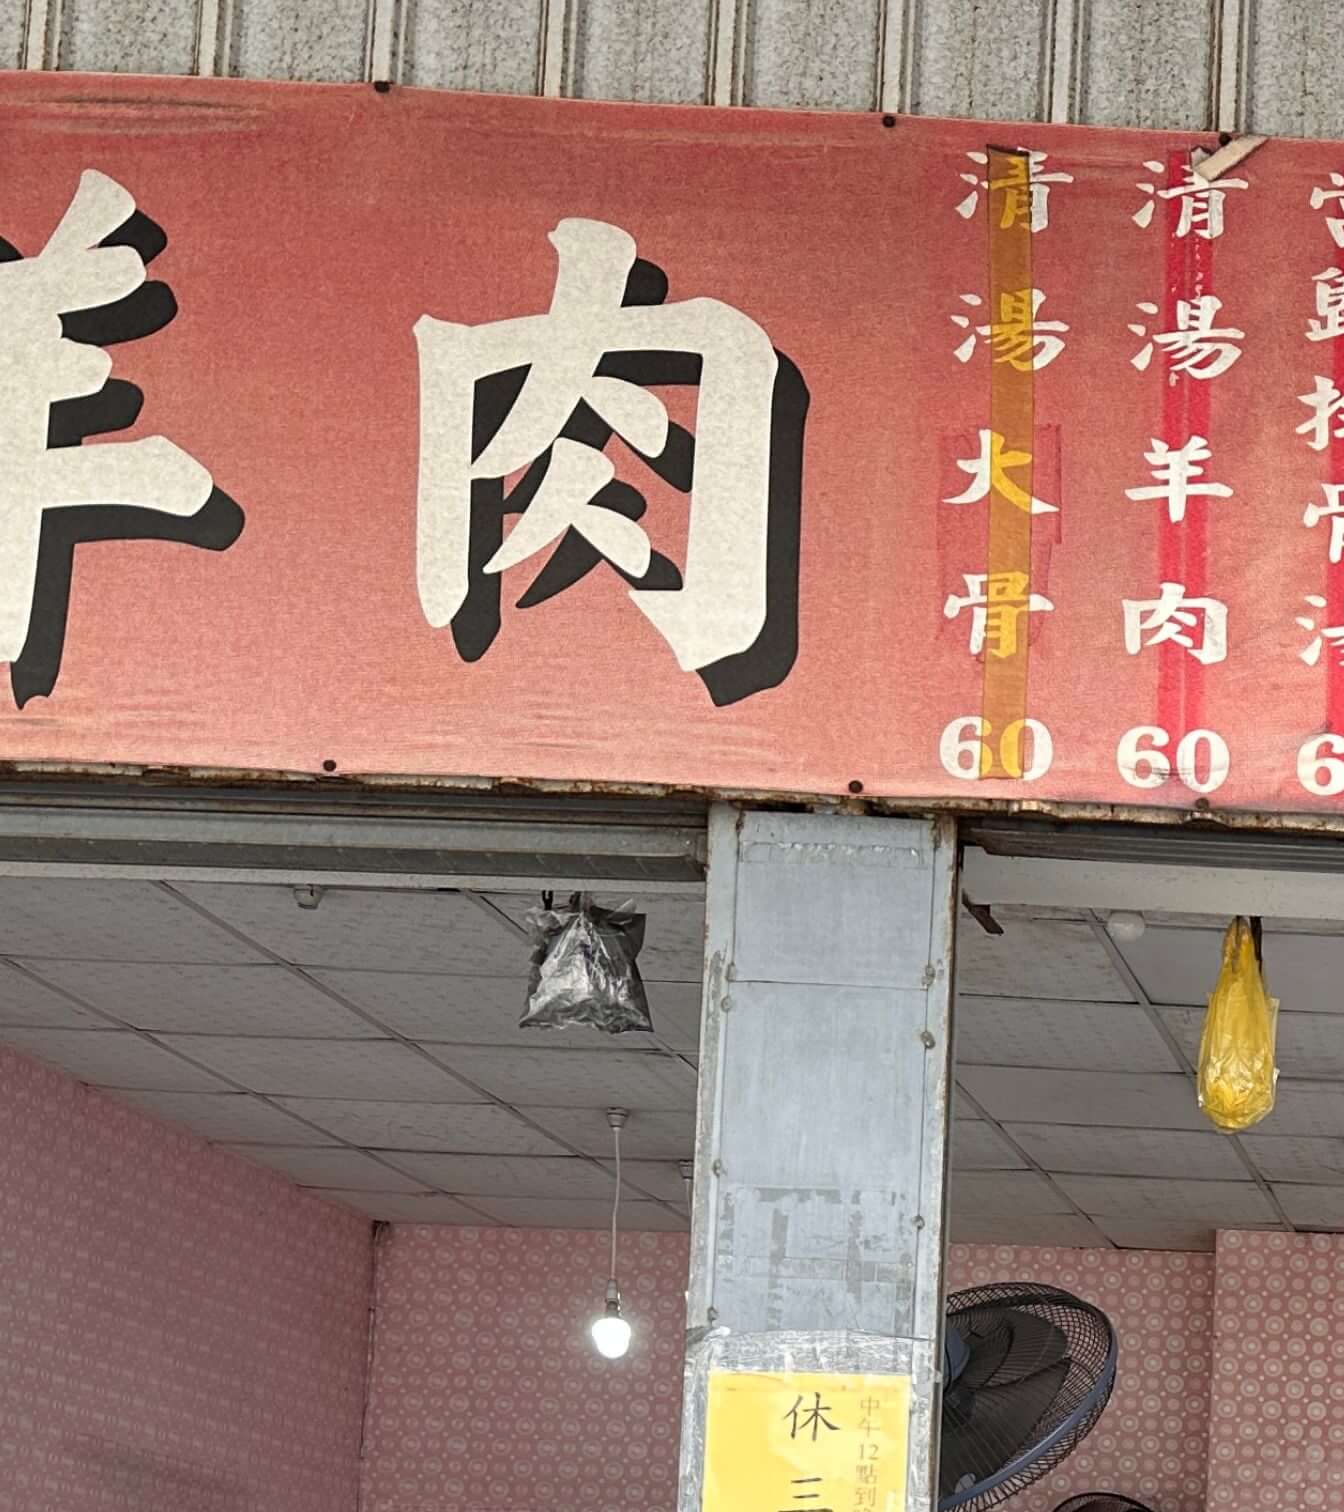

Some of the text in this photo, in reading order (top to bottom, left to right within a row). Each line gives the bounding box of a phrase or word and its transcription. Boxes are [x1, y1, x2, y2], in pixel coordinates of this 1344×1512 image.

[939, 146, 1073, 782] 清湯大骨 60
[1116, 155, 1249, 794] 清湯羊肉 60
